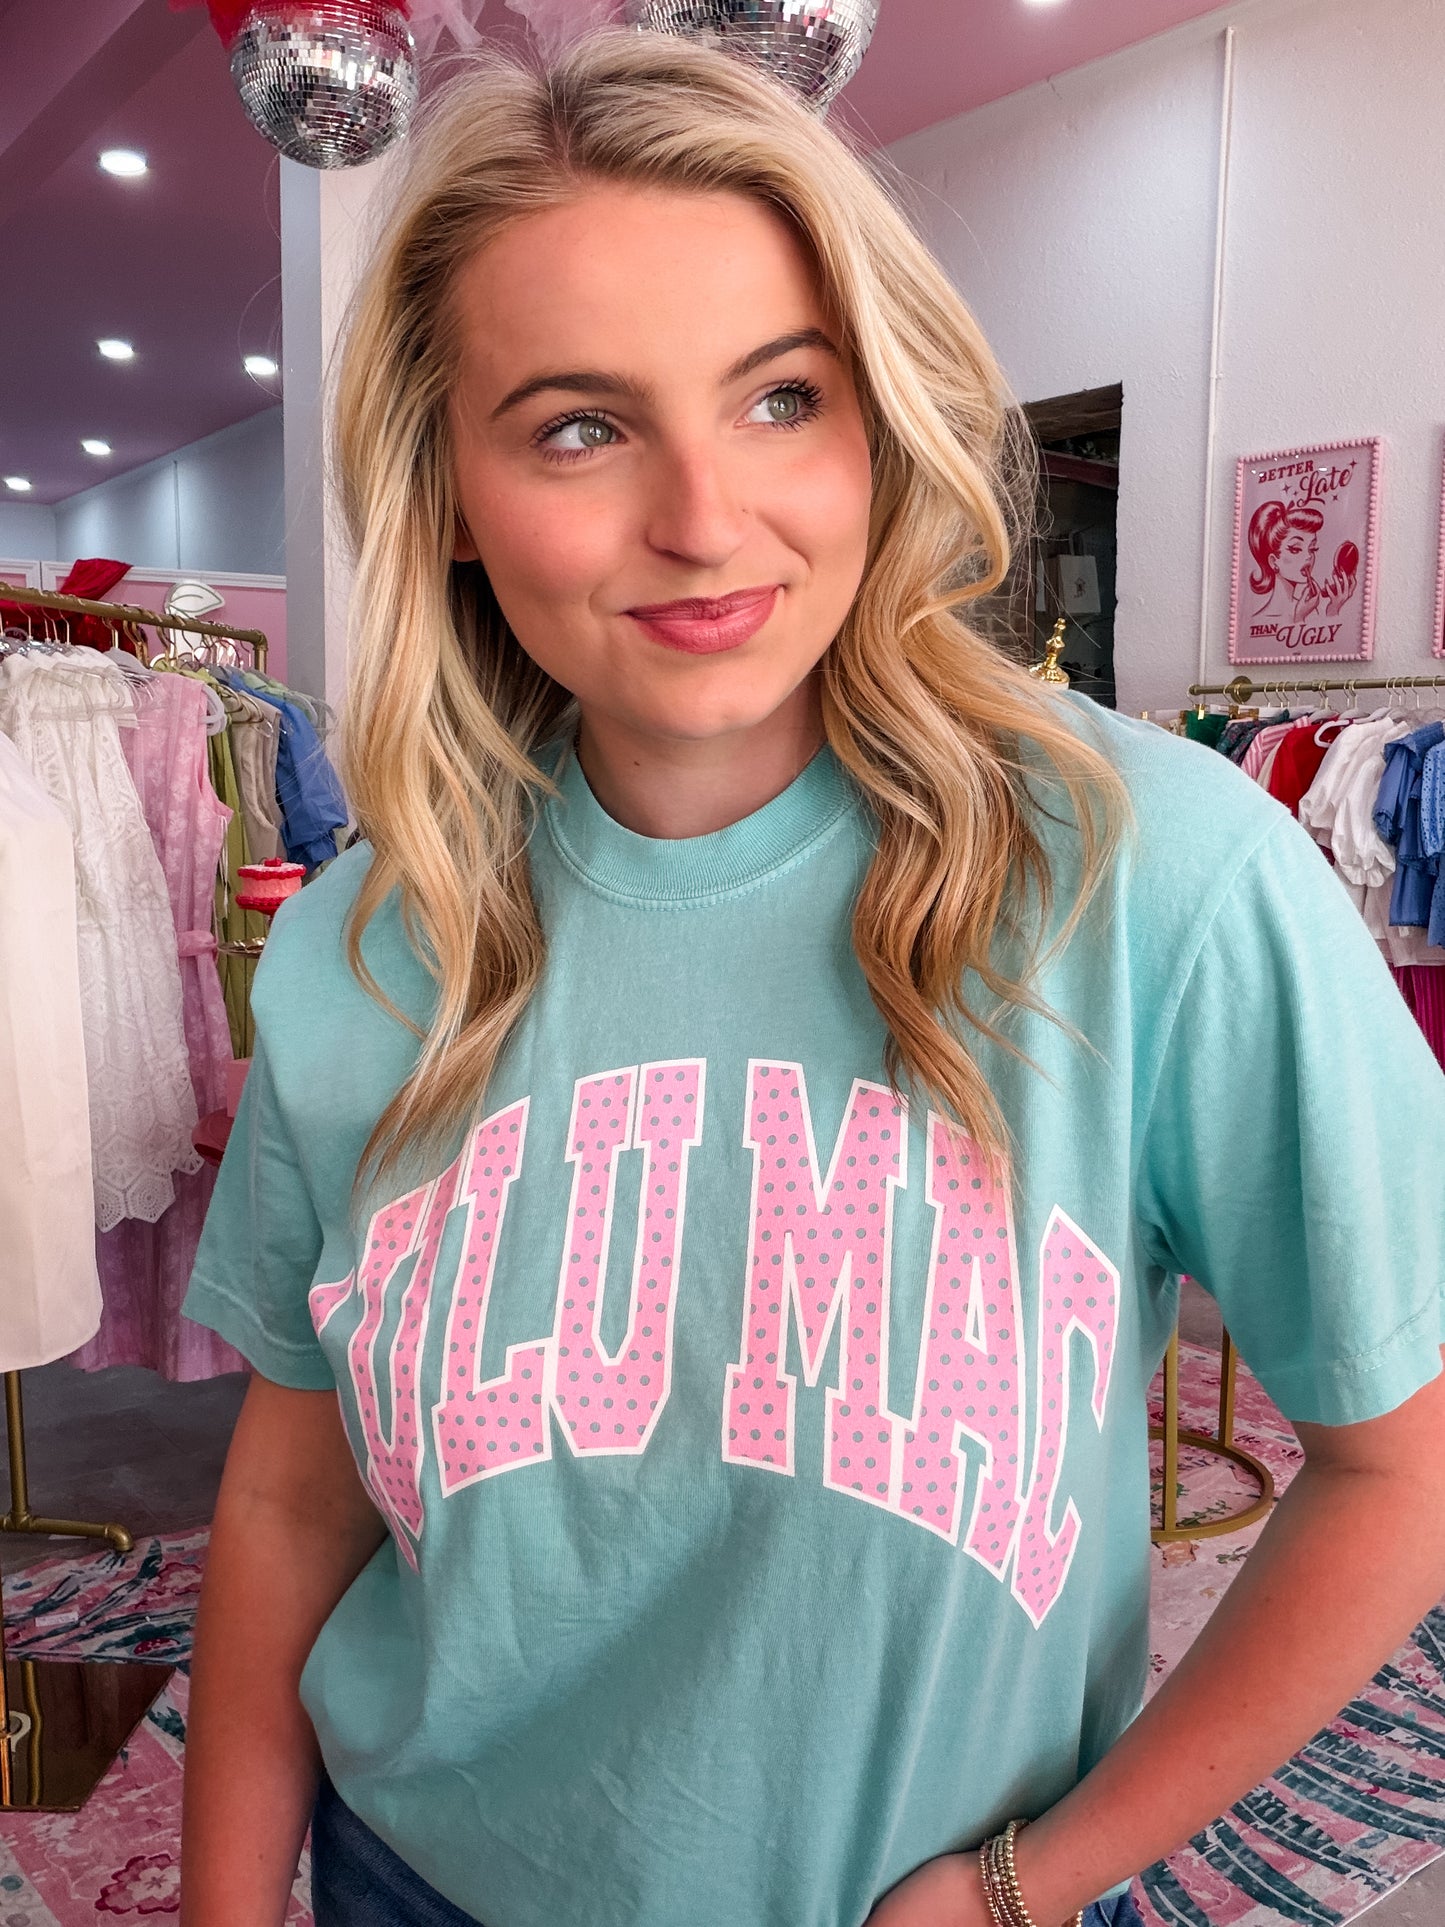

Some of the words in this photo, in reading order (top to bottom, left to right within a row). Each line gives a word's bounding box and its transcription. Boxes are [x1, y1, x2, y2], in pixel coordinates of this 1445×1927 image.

[1258, 460, 1314, 483] BETTER
[1297, 466, 1352, 507] Late
[1250, 623, 1278, 637] THAN
[1276, 624, 1342, 648] UGLY
